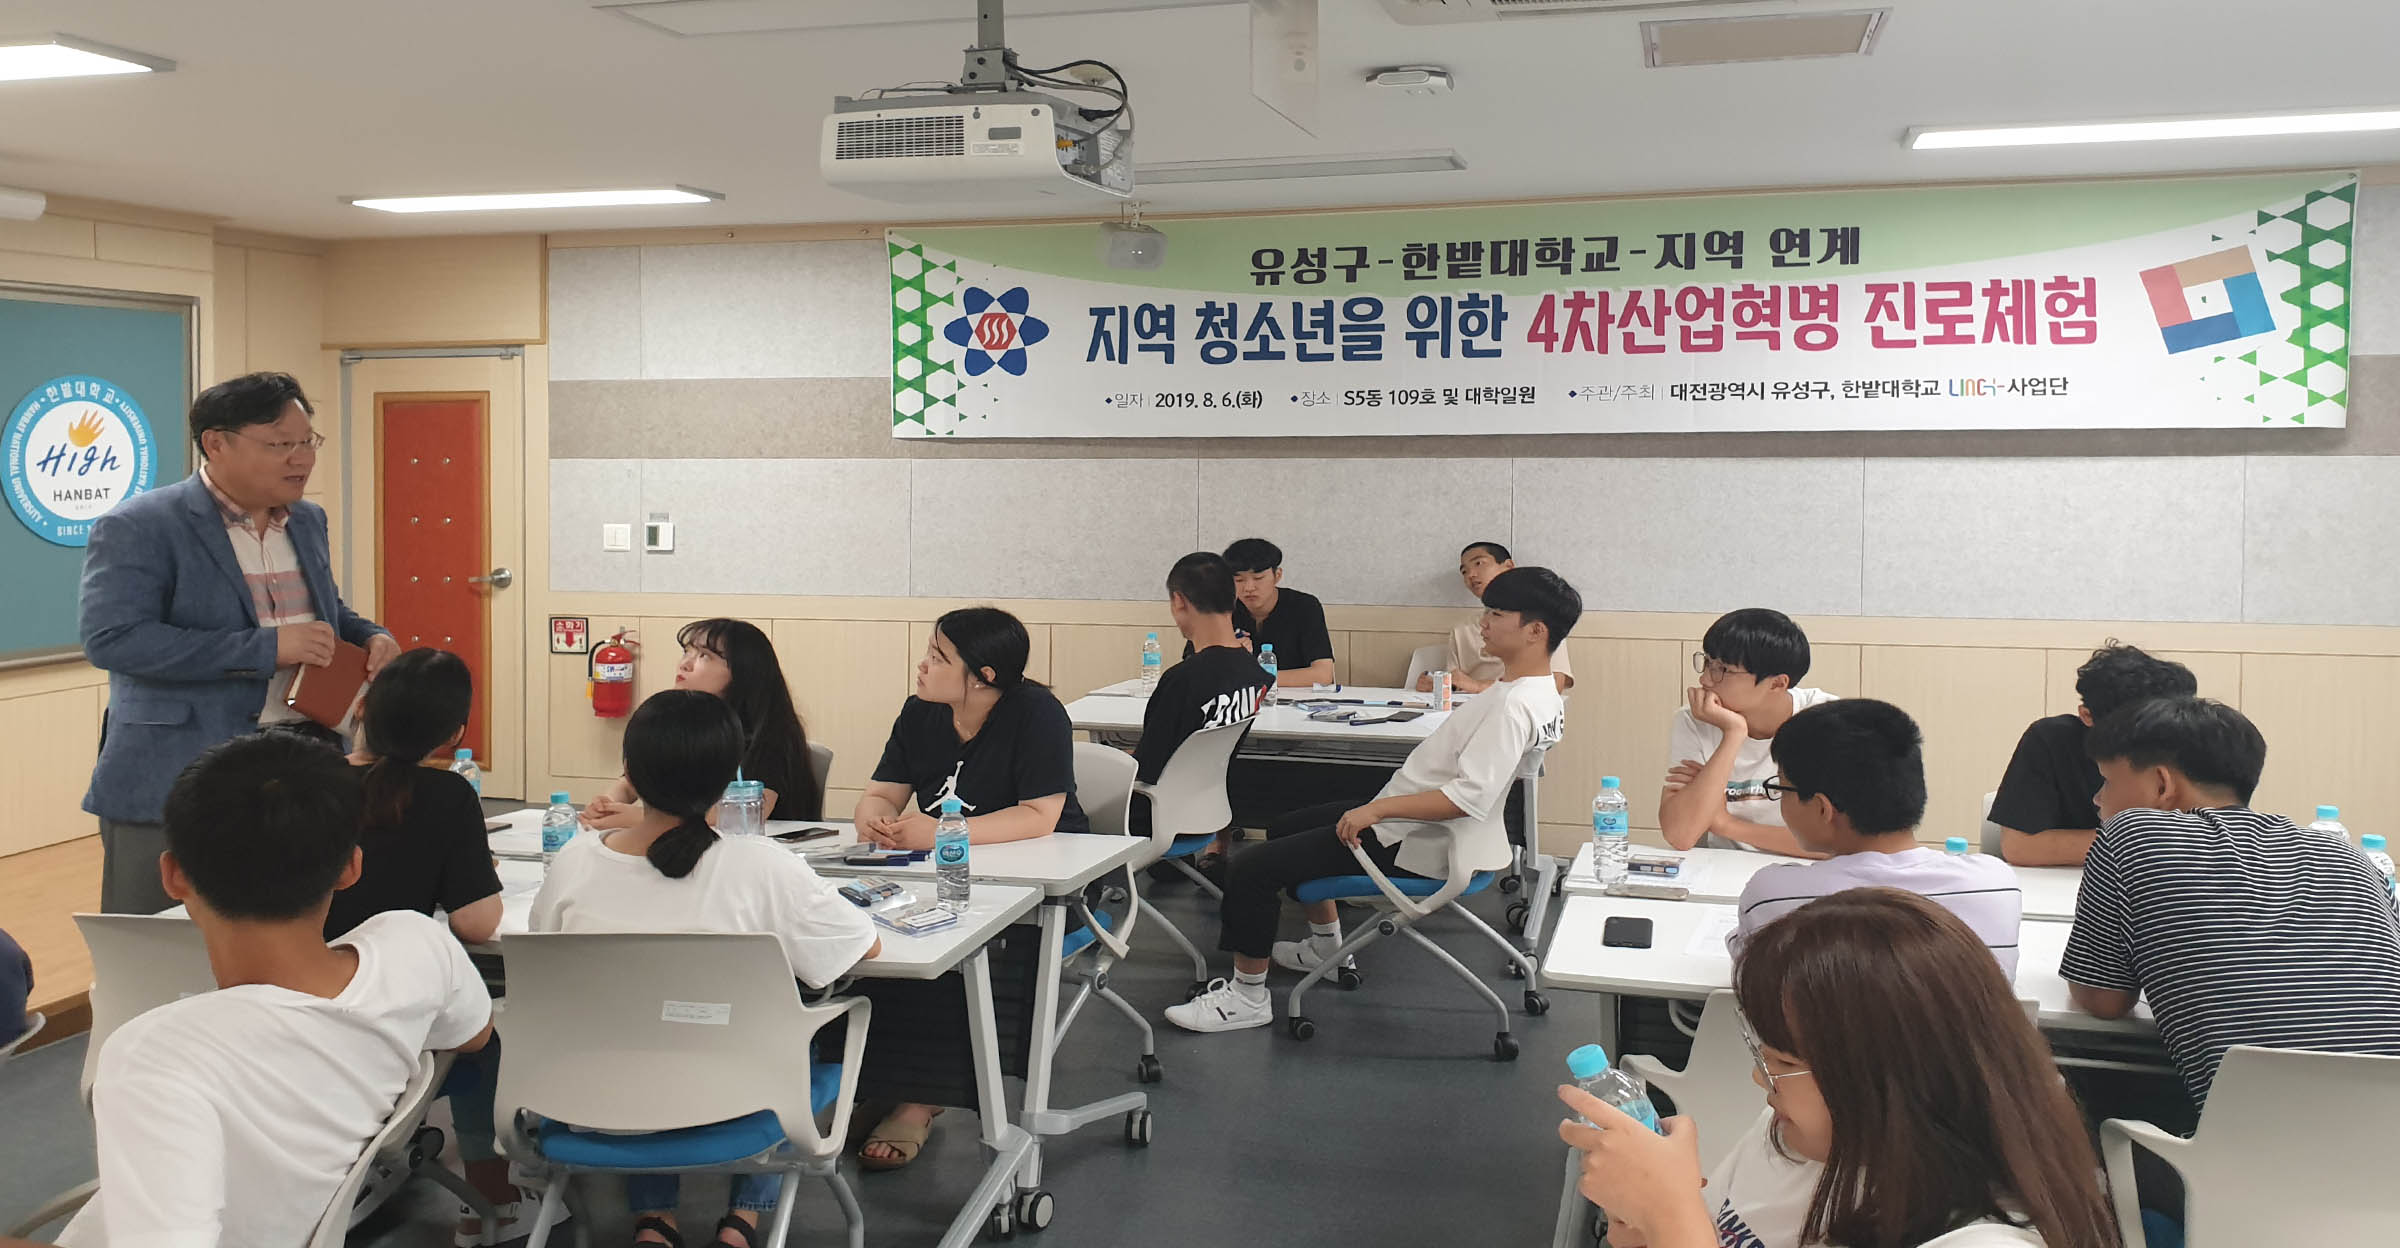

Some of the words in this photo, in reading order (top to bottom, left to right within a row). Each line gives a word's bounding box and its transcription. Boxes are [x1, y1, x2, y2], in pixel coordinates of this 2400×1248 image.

[1769, 226, 1861, 267] 연계
[1086, 303, 1175, 365] 지역
[1194, 296, 1386, 365] 청소년을
[1405, 293, 1508, 359] 위한
[1527, 283, 1839, 355] 4차산업혁명
[1864, 275, 2097, 349] 진로체험
[46, 380, 117, 405] 한밭대학교
[1114, 392, 1143, 408] 일자
[1155, 392, 1198, 408] 2019.
[1203, 392, 1217, 408] 8.
[1222, 390, 1263, 409] 6.(화)
[1302, 391, 1331, 407] 장소
[1344, 389, 1383, 407] S5동
[1388, 388, 1437, 406] 109호
[1442, 387, 1459, 405] 및
[1465, 386, 1536, 405] 대학일원
[1579, 383, 1655, 402] 주관/주최
[1670, 381, 1765, 401] 대전광역시
[1771, 380, 1835, 401] 유성구,
[1841, 379, 1941, 399] 한밭대학교
[9, 431, 22, 477] NATIONAL
[11, 477, 43, 523] UNIVERSITY
[53, 487, 111, 502] HANBAT
[57, 524, 84, 537] SINCE
